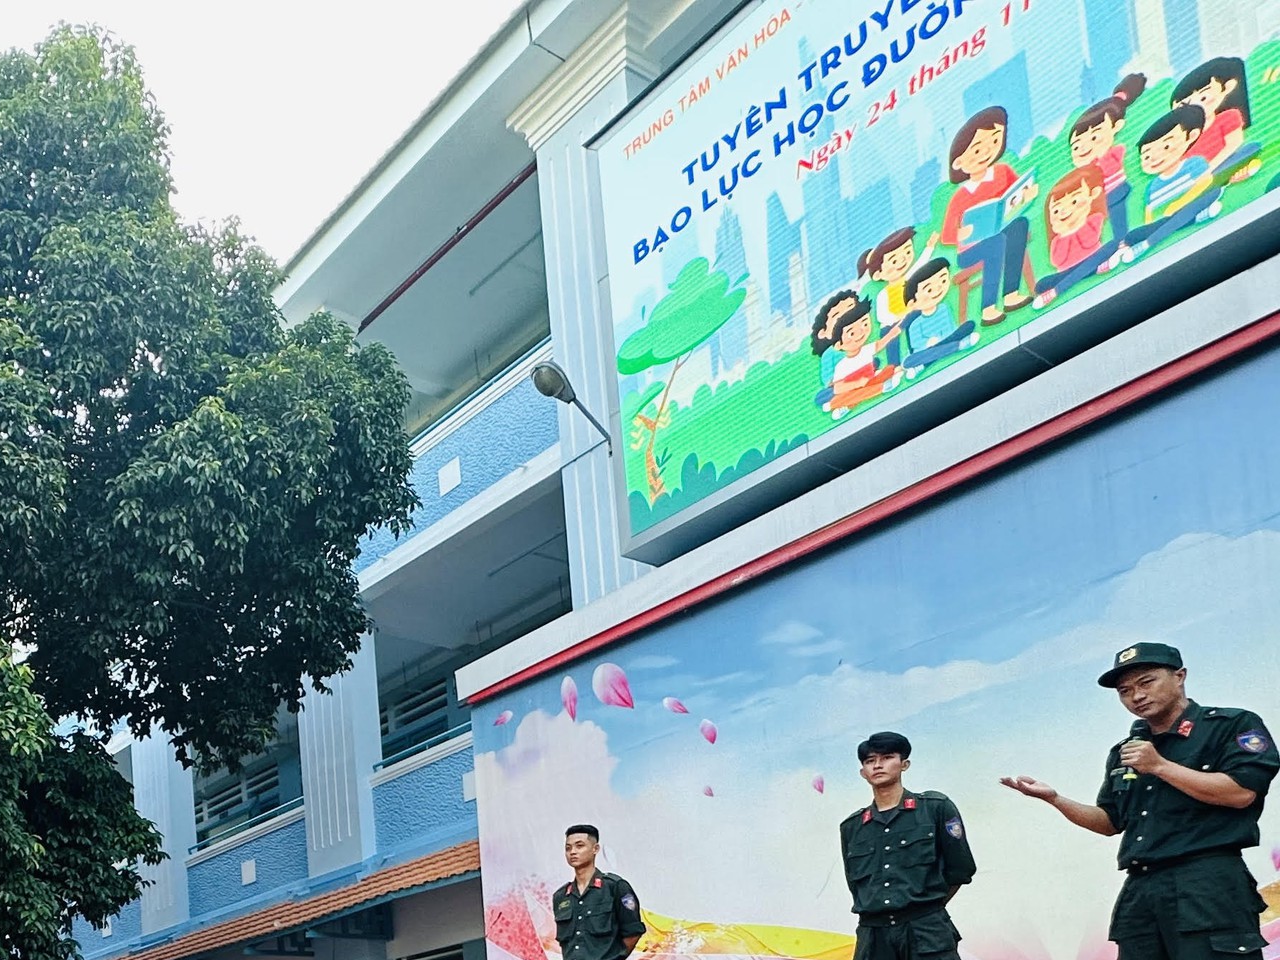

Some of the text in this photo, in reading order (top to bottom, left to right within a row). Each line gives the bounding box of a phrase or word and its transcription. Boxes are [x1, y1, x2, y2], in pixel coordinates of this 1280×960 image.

[624, 109, 675, 160] TRUNG
[678, 77, 711, 114] TÂM
[682, 87, 788, 186] TUYÊN
[796, 123, 857, 181] Ngày
[865, 88, 898, 129] 24
[908, 24, 987, 96] tháng
[633, 206, 692, 266] BẠO
[773, 80, 851, 157] HỌC
